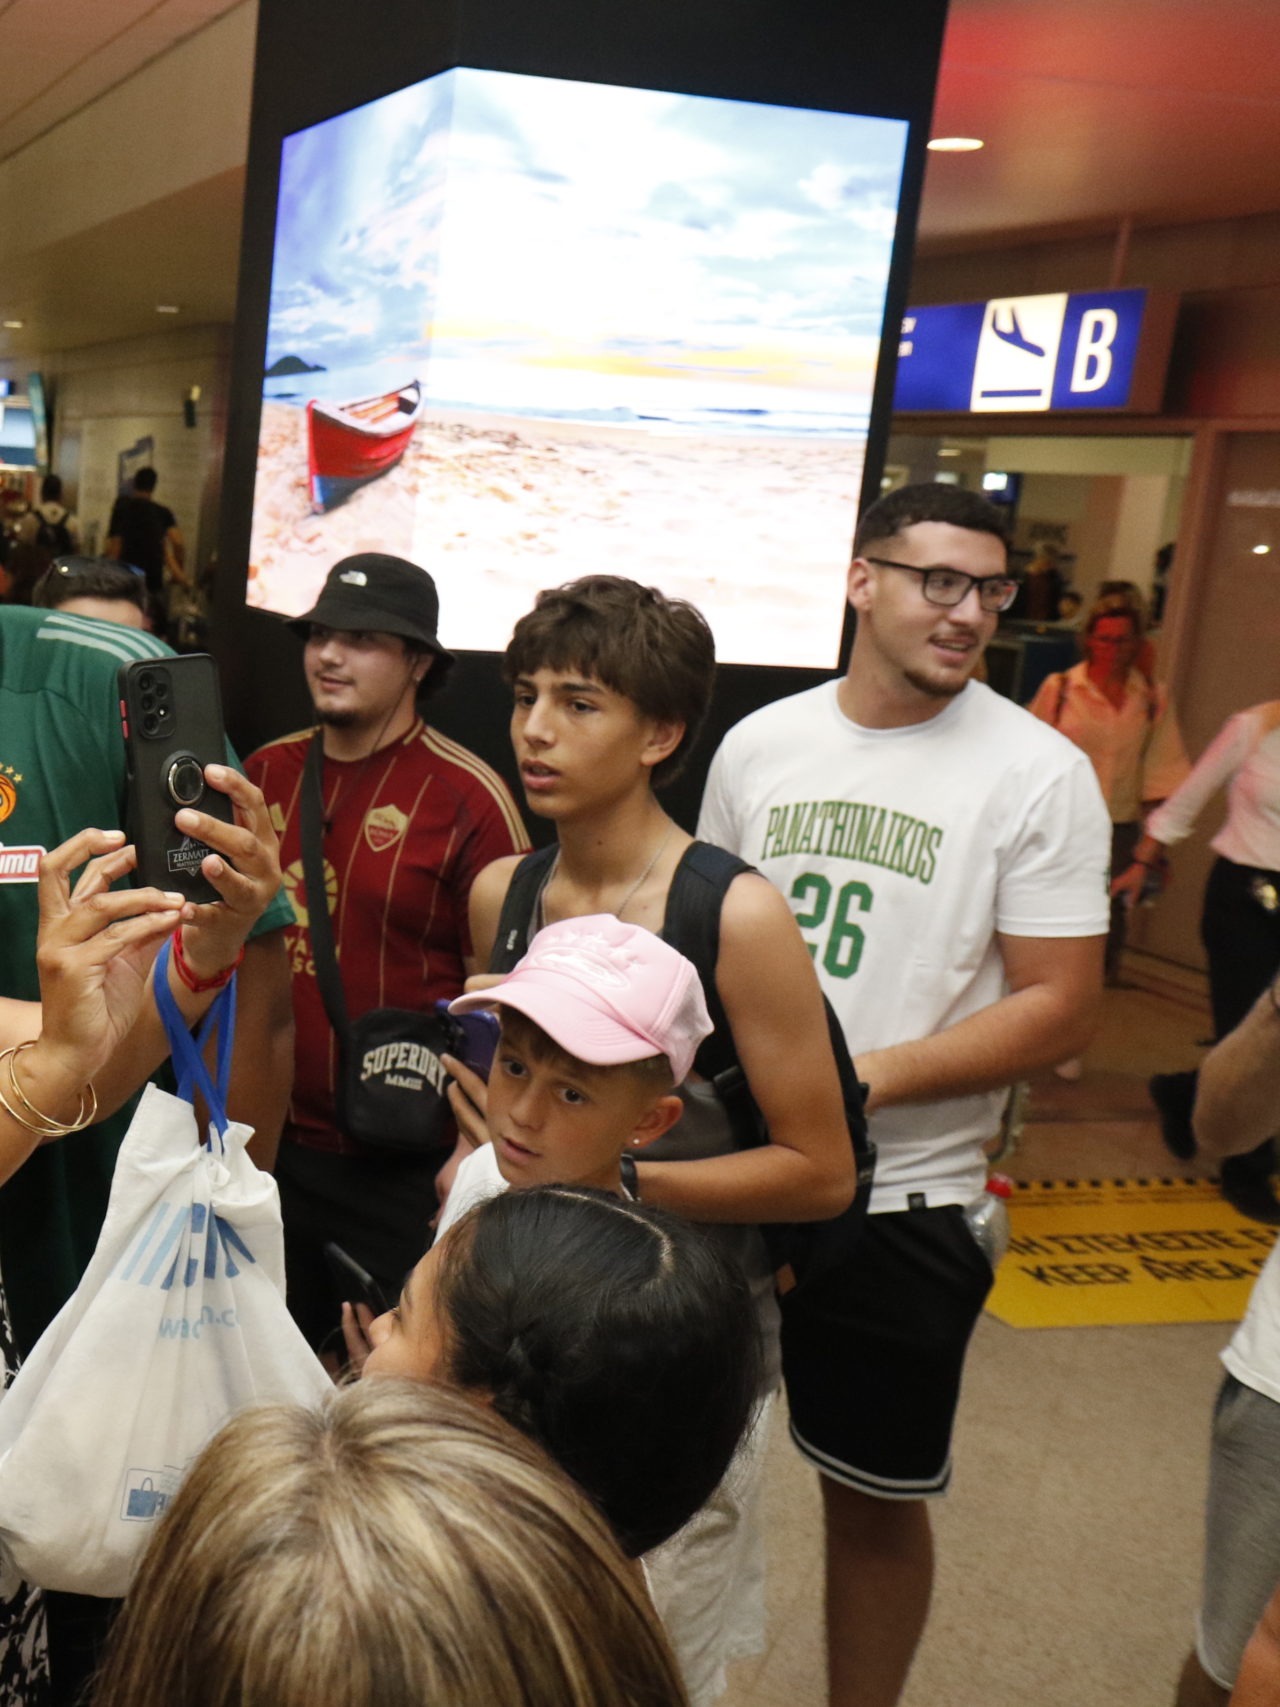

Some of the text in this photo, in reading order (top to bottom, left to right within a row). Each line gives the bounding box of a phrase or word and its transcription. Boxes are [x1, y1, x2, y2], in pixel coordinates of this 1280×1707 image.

[1070, 308, 1118, 393] B
[761, 800, 944, 885] PANATHINAIKOS
[790, 872, 874, 979] 26
[360, 1042, 447, 1097] SUPERDRY
[1020, 1263, 1132, 1286] KEEP
